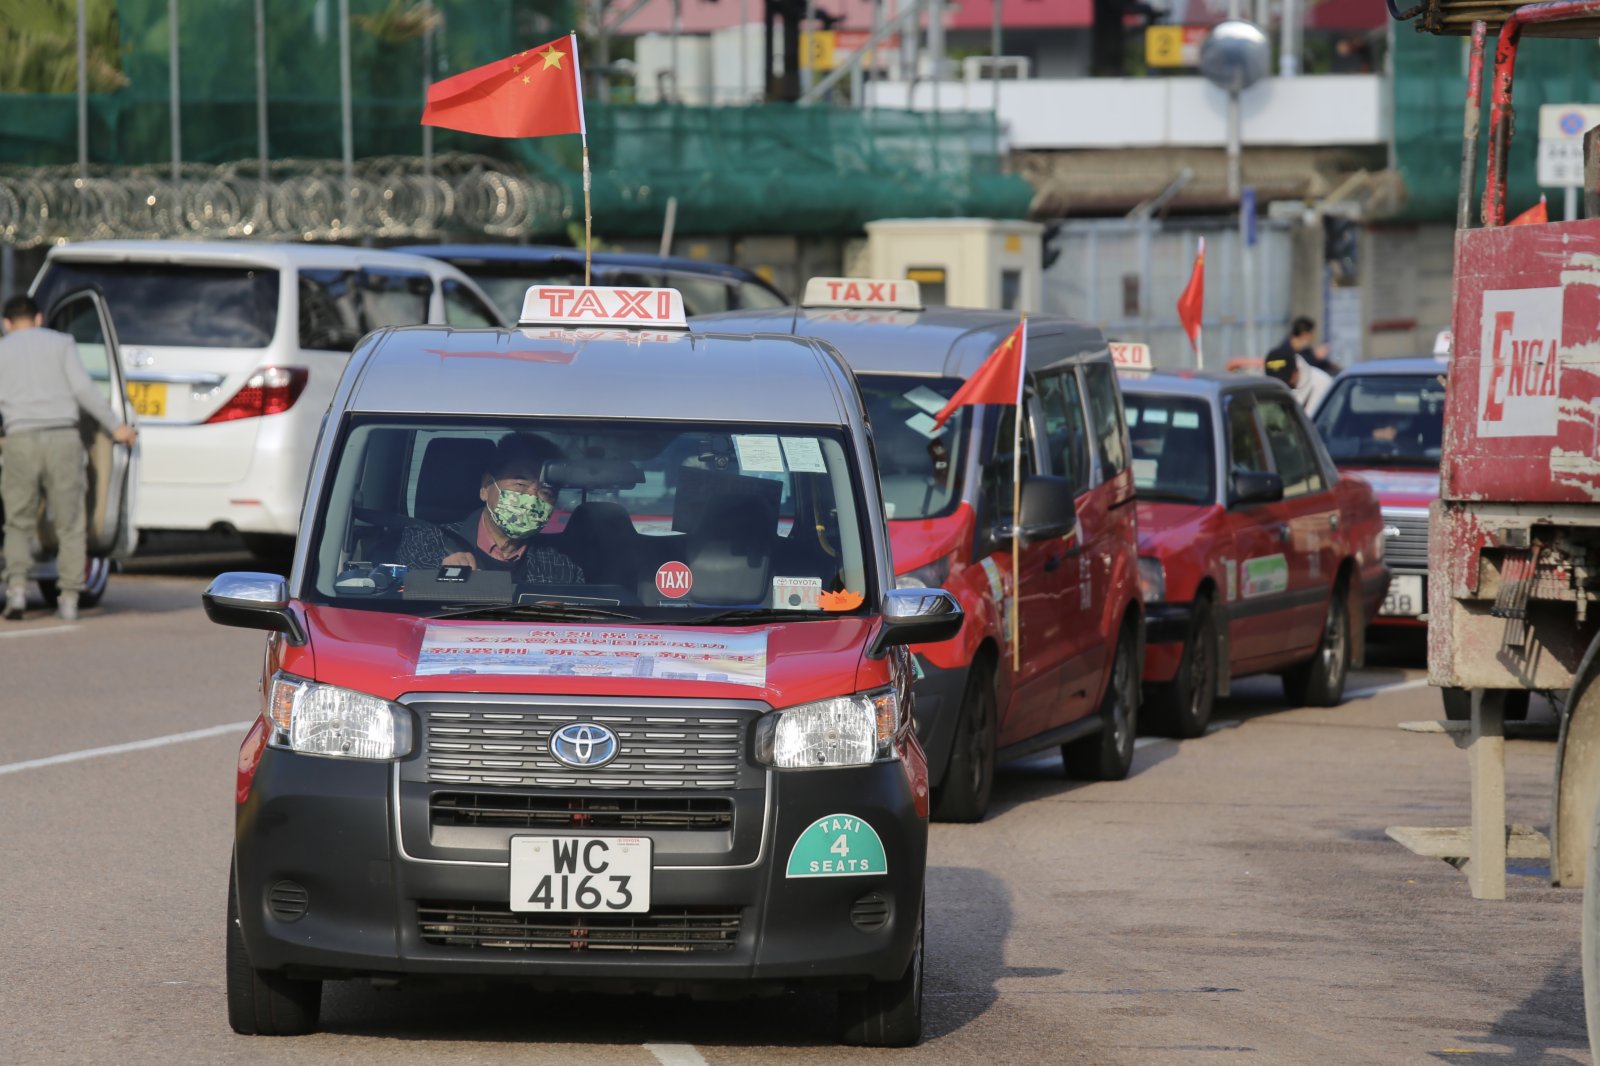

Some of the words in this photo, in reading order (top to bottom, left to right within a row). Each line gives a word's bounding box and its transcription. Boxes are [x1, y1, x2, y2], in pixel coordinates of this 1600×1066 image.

[826, 281, 897, 303] TAXI
[538, 288, 671, 320] TAXI
[1482, 311, 1558, 421] ENGA
[658, 570, 690, 589] TAXI
[788, 579, 818, 587] TOYOTA
[429, 647, 529, 656] 新選制
[544, 648, 640, 659] 新立會
[819, 818, 861, 834] TAXI
[829, 833, 850, 857] 4
[552, 839, 610, 874] WC
[809, 859, 869, 872] SEATS
[527, 875, 633, 910] 4163
